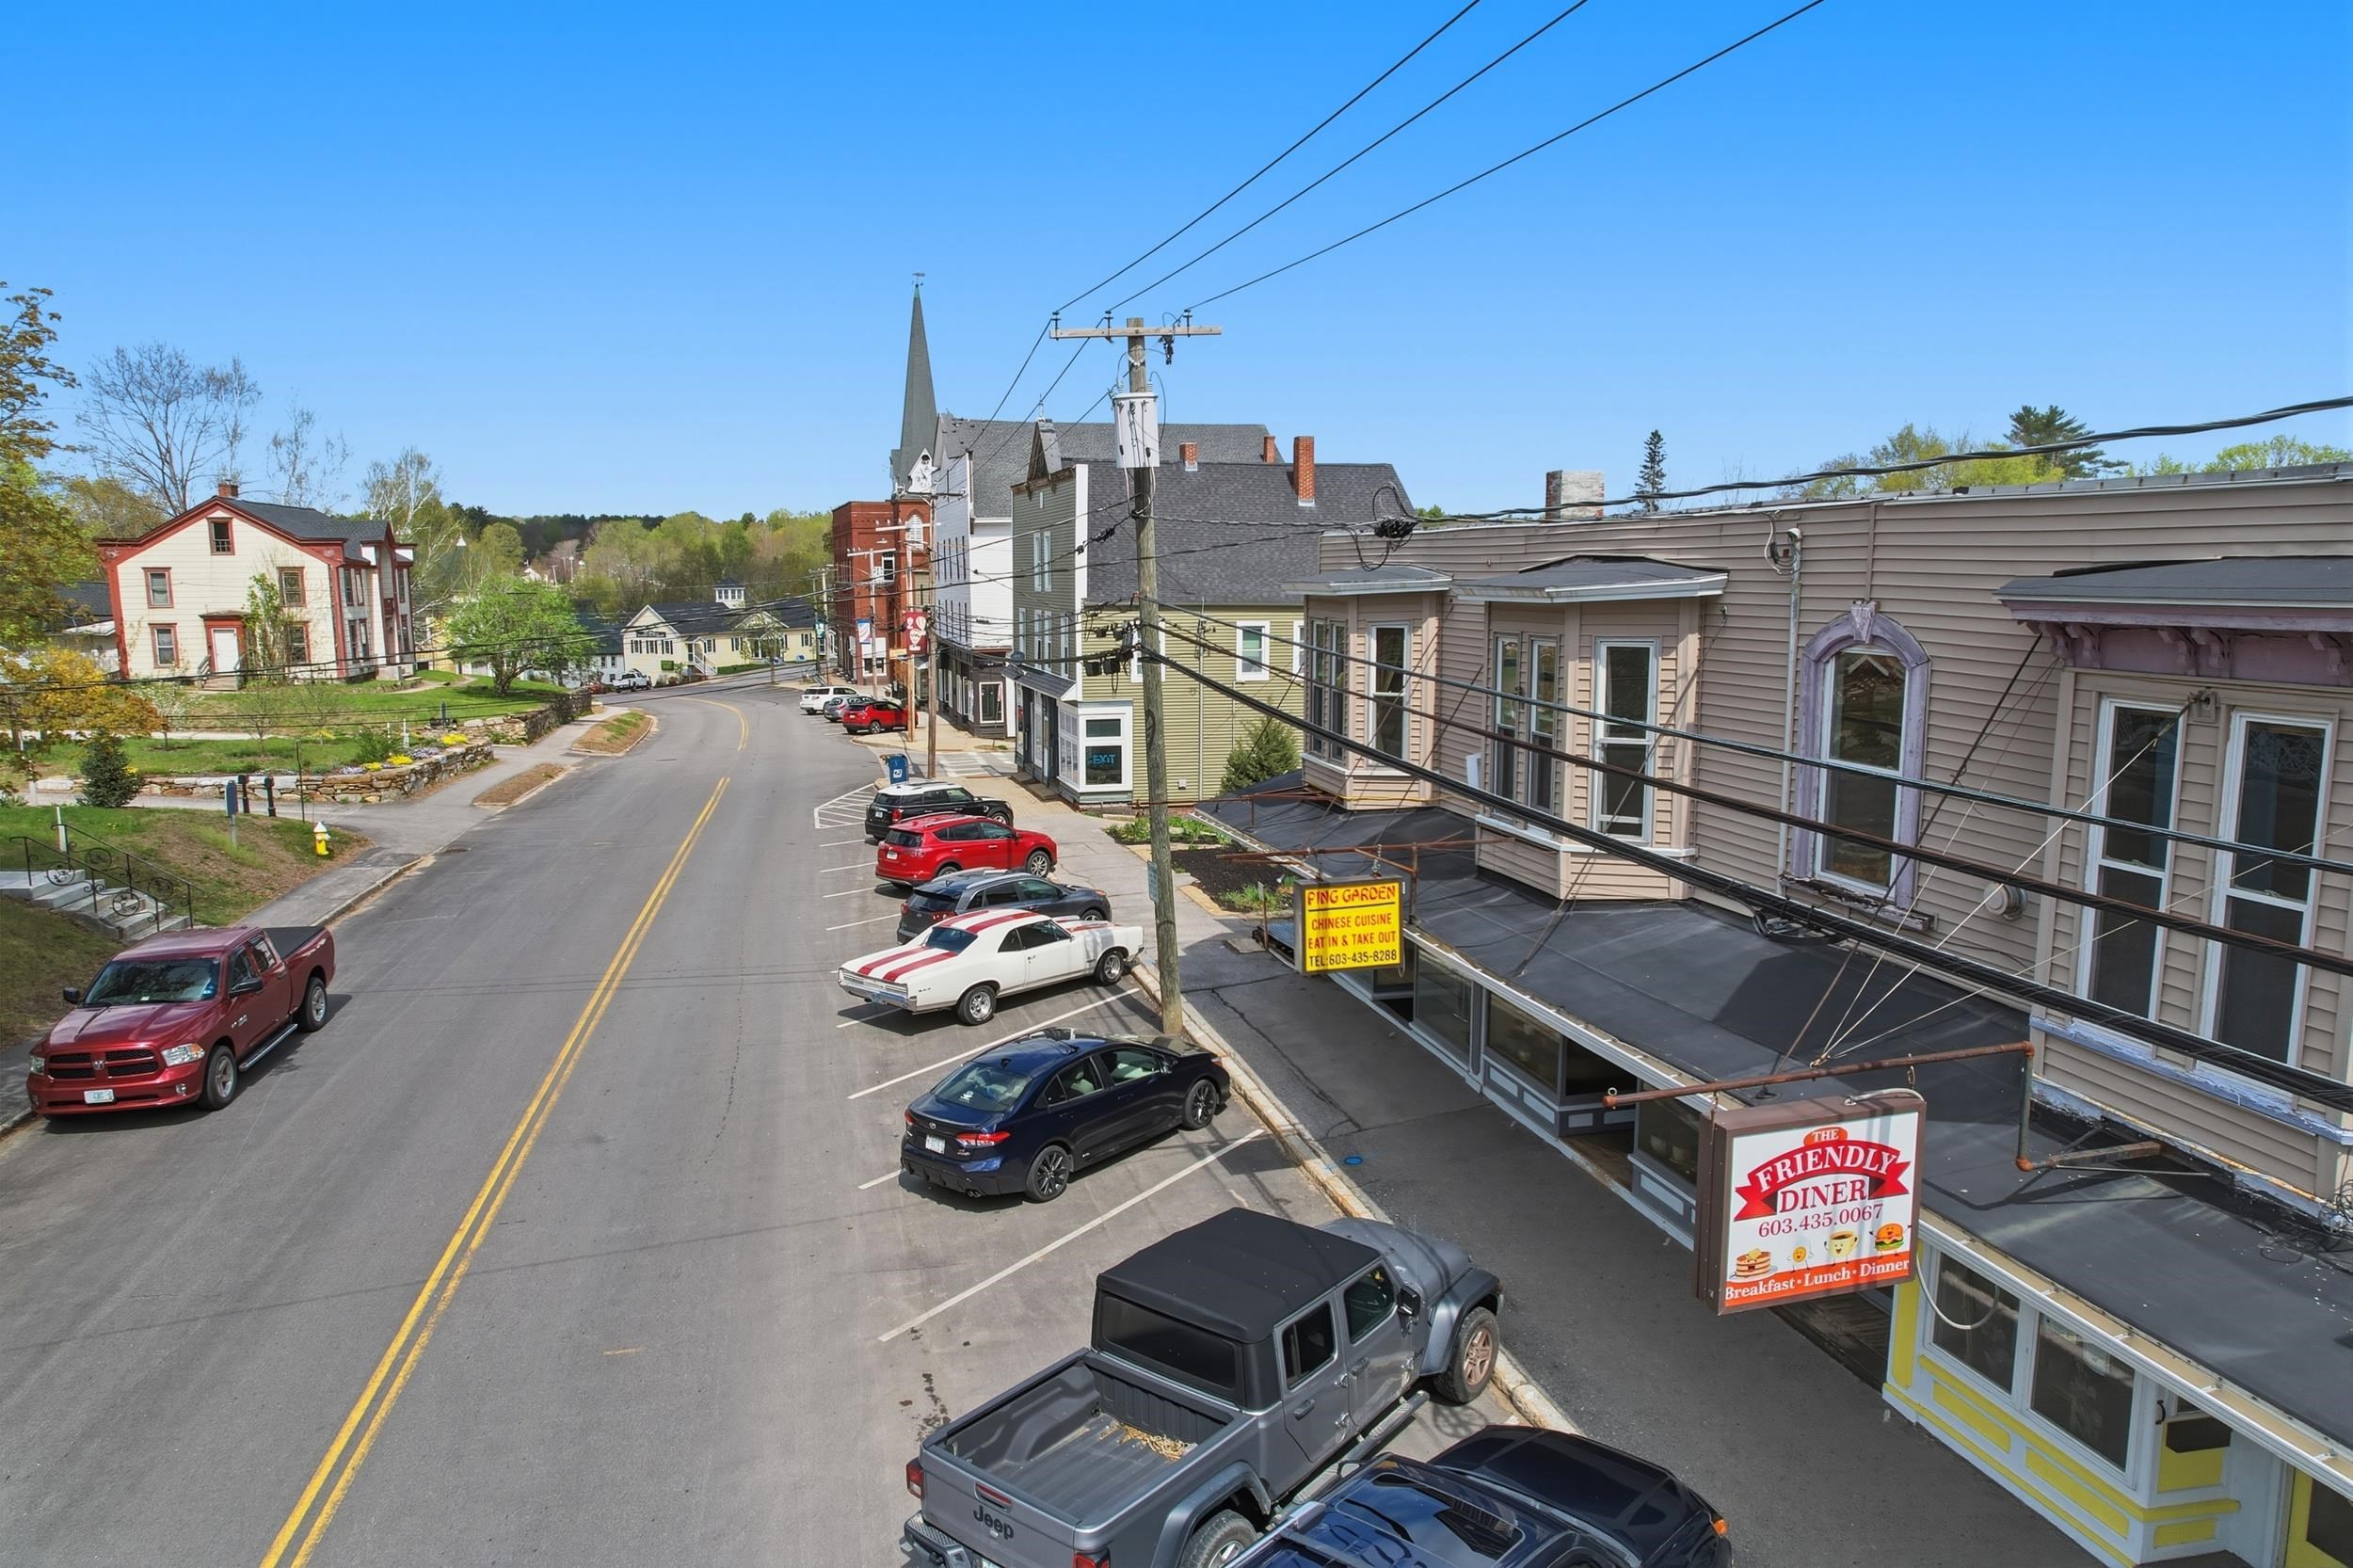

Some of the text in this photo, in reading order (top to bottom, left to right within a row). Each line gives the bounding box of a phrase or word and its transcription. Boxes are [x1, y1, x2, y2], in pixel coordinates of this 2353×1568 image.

[1307, 887, 1396, 905] PING GARDEN
[1311, 913, 1392, 930] CHINESE CUISINE
[1308, 931, 1396, 949] EAT IN & TAKE OUT
[1812, 1128, 1839, 1142] THE
[1755, 1145, 1897, 1192] FRIENDLY
[1779, 1179, 1867, 1213] DINER
[1758, 1204, 1883, 1238] 603.435.0067
[1725, 1260, 1909, 1300] Breakfast Lunch Dinner
[973, 1505, 1014, 1540] Jeep
